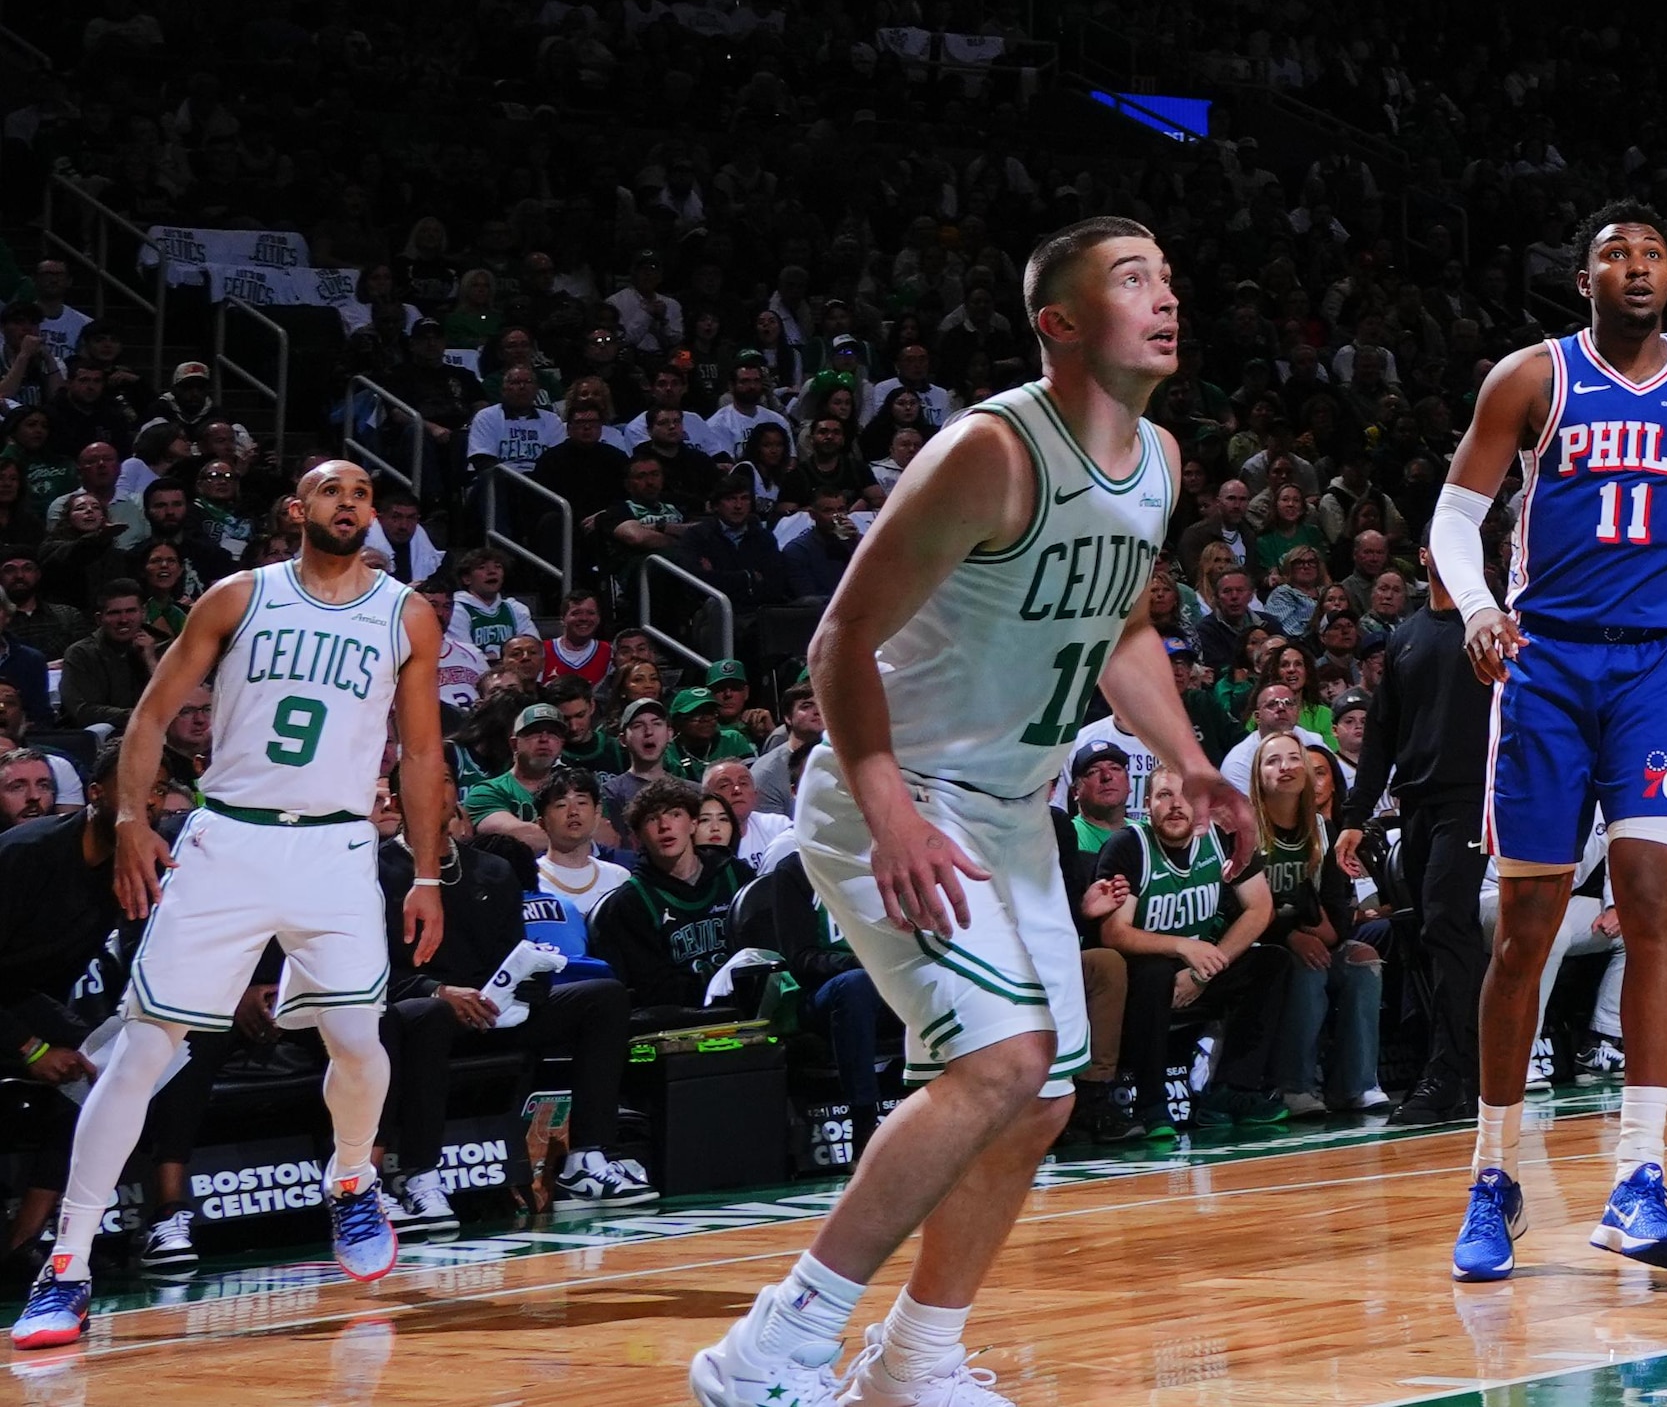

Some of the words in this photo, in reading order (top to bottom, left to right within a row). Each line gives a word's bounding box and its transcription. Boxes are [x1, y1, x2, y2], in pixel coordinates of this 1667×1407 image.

[1596, 481, 1653, 545] 11
[247, 629, 380, 700] CELTICS
[1019, 640, 1110, 747] 11
[266, 696, 327, 767] 9
[1145, 881, 1221, 933] BOSTON
[191, 1160, 323, 1198] BOSTON
[202, 1178, 323, 1220] CELTICS
